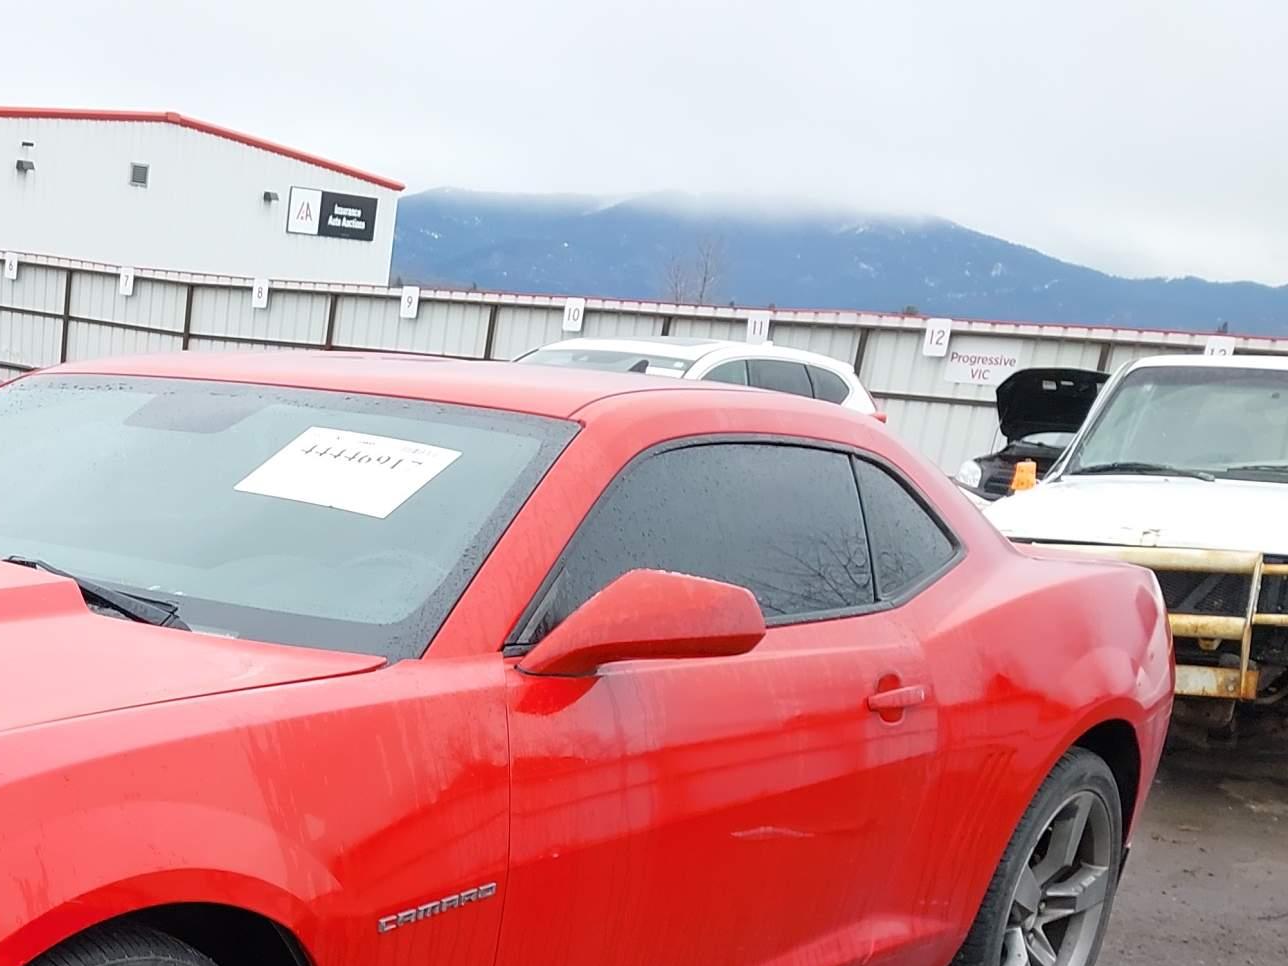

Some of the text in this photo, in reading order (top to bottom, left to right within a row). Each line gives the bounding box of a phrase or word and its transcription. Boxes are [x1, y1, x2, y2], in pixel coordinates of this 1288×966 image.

[327, 214, 366, 230] Auto Auctions
[406, 295, 413, 308] 9
[567, 306, 581, 322] 10
[752, 319, 763, 337] 11
[929, 328, 946, 346] 12
[950, 351, 1017, 367] Progressive
[970, 369, 991, 381] VIC
